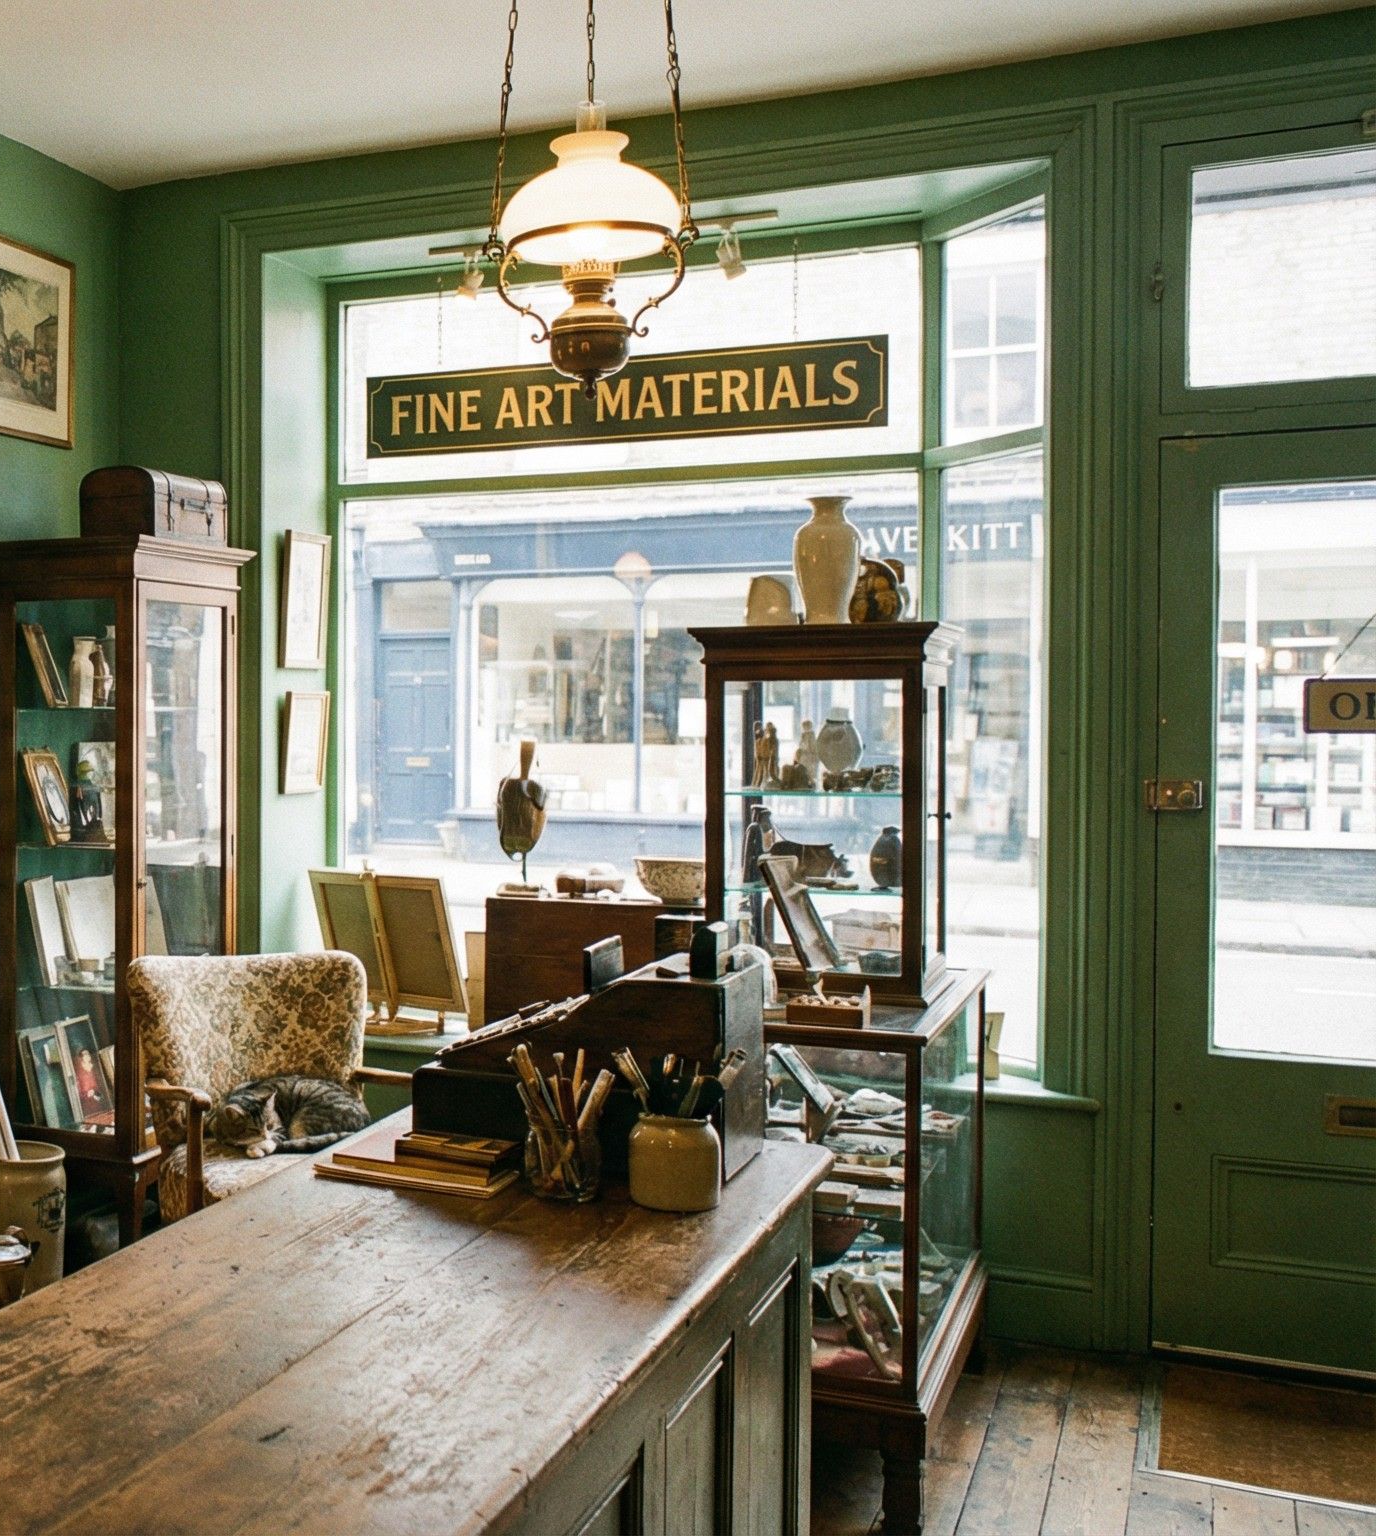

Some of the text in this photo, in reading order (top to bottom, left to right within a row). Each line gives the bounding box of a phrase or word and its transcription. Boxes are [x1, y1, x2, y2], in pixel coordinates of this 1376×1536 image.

[391, 360, 860, 436] FINE ART MATERIALS
[947, 522, 1024, 551] KITT
